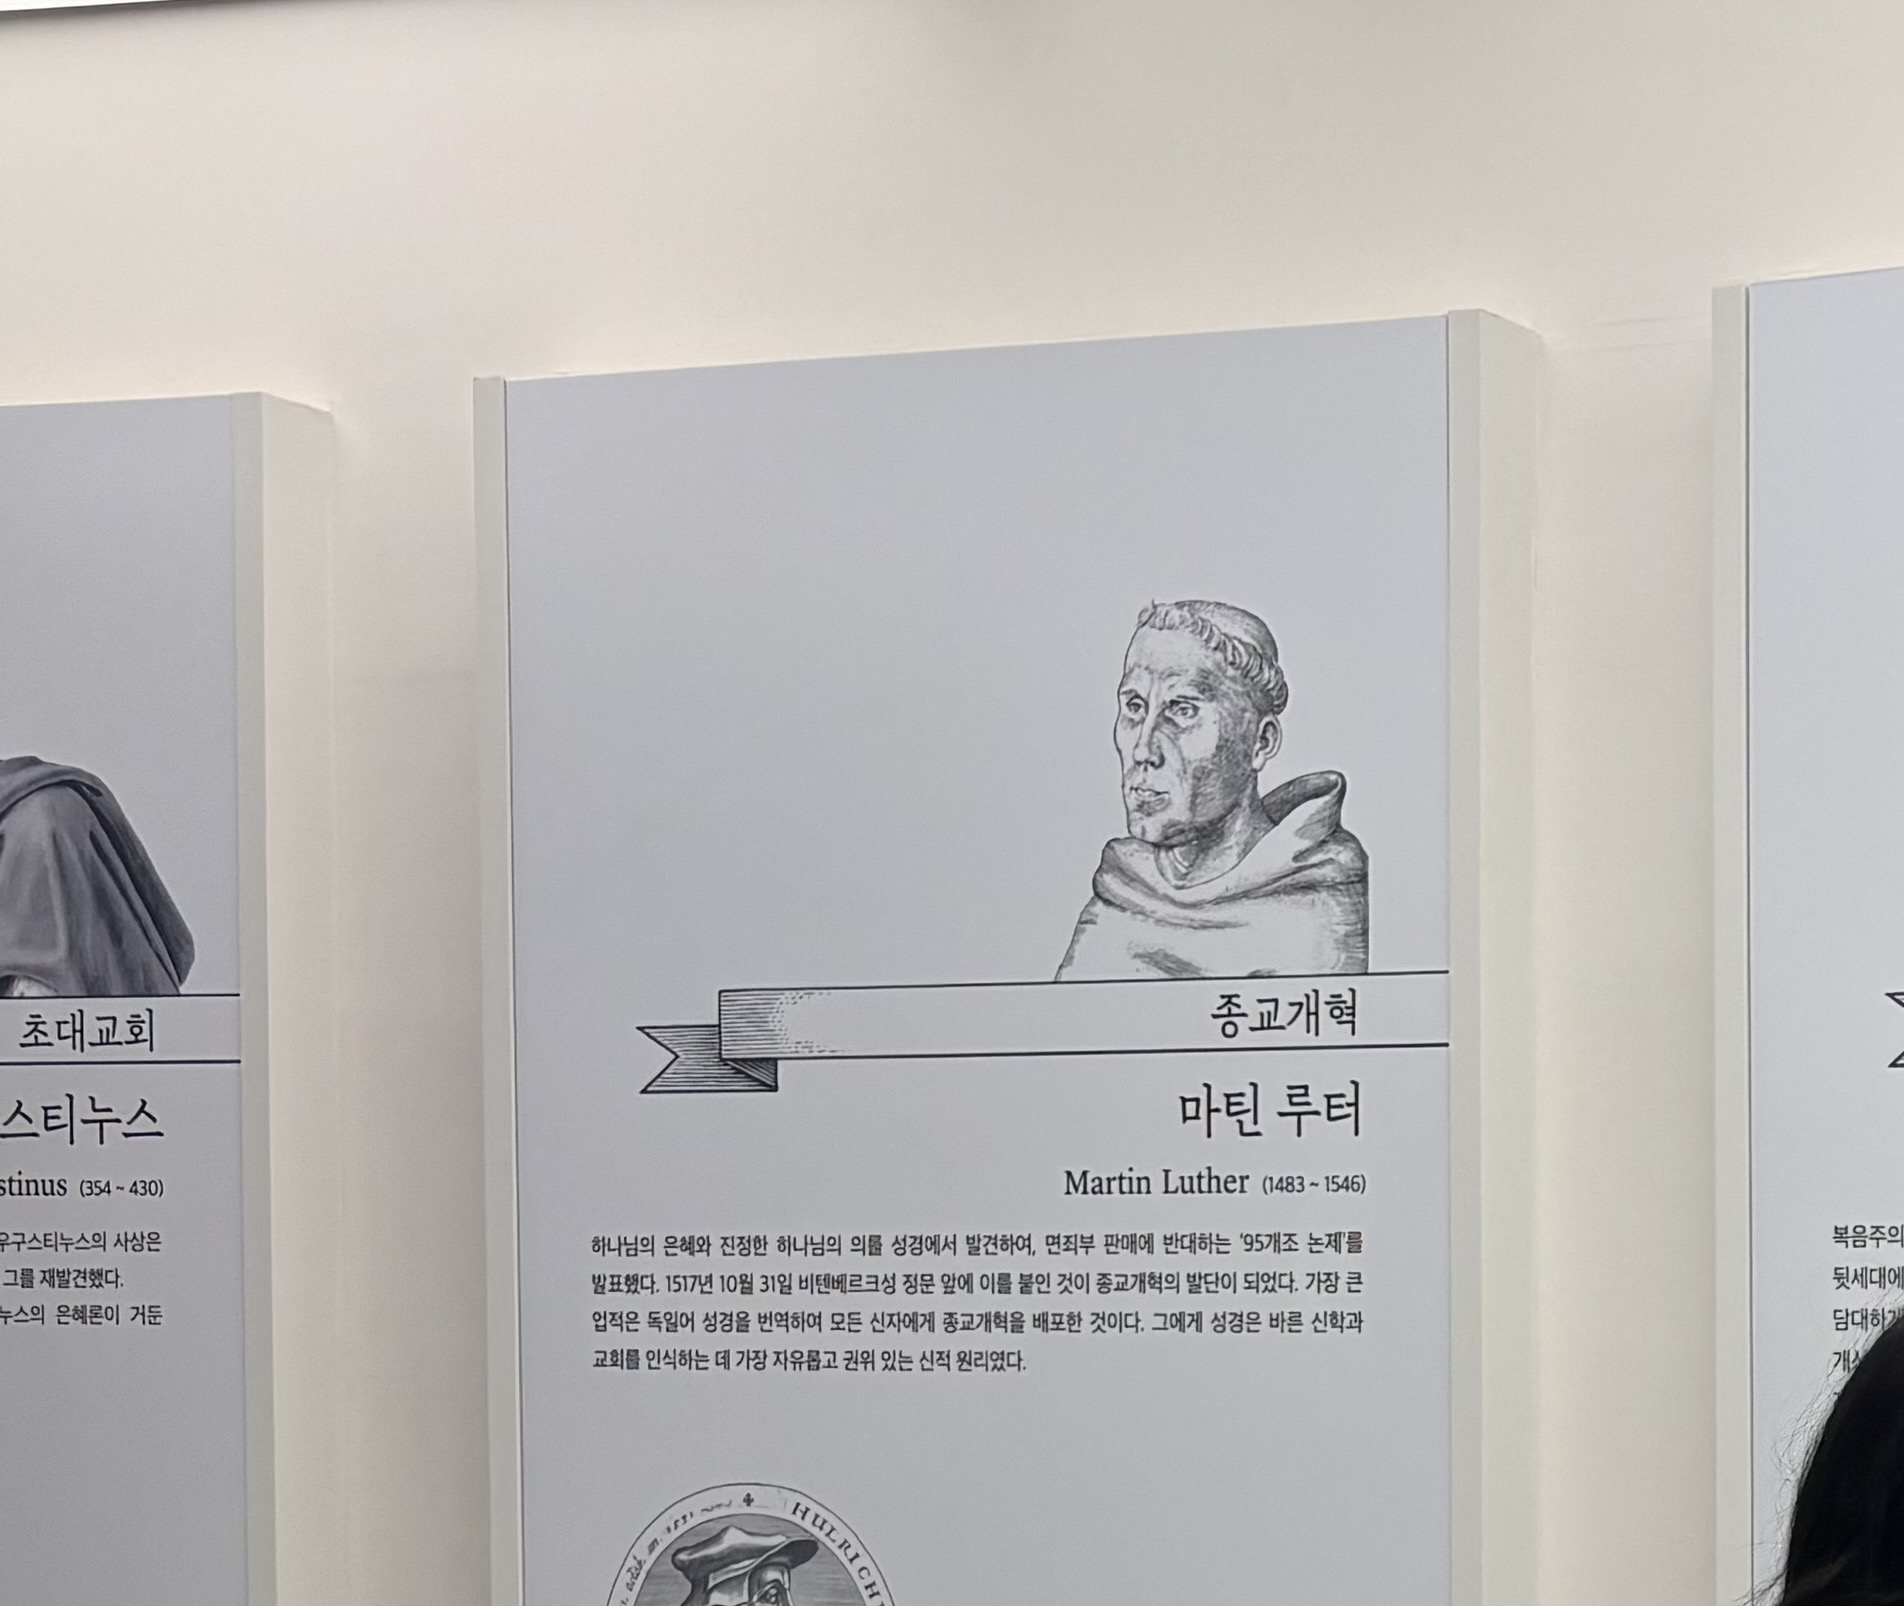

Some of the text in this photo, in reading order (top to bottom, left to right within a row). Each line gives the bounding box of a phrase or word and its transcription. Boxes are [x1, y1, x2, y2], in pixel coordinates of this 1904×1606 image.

[1210, 987, 1357, 1039] 종교개혁
[18, 1007, 154, 1054] 초대교회
[1178, 1079, 1360, 1139] 마틴 루터
[1063, 1166, 1153, 1196] Martin
[1161, 1165, 1250, 1195] Luther
[113, 1230, 163, 1253] 사상은
[1831, 1223, 1904, 1250] 복음주의
[2, 1267, 35, 1289] 그를
[55, 1303, 164, 1326] 은혜론이 거둔
[591, 1310, 641, 1334] 업적은
[646, 1310, 695, 1334] 독일어
[701, 1310, 752, 1334] 성경을
[757, 1310, 823, 1334] 번역하여
[829, 1311, 864, 1334] 모든
[869, 1310, 936, 1334] 신자에게
[942, 1310, 1026, 1334] 종교개혁을
[1032, 1310, 1084, 1334] 배포한
[1151, 1310, 1203, 1334] 그에게
[1210, 1310, 1263, 1334] 성경은
[1268, 1310, 1304, 1334] 바른
[1311, 1310, 1365, 1334] 신학과
